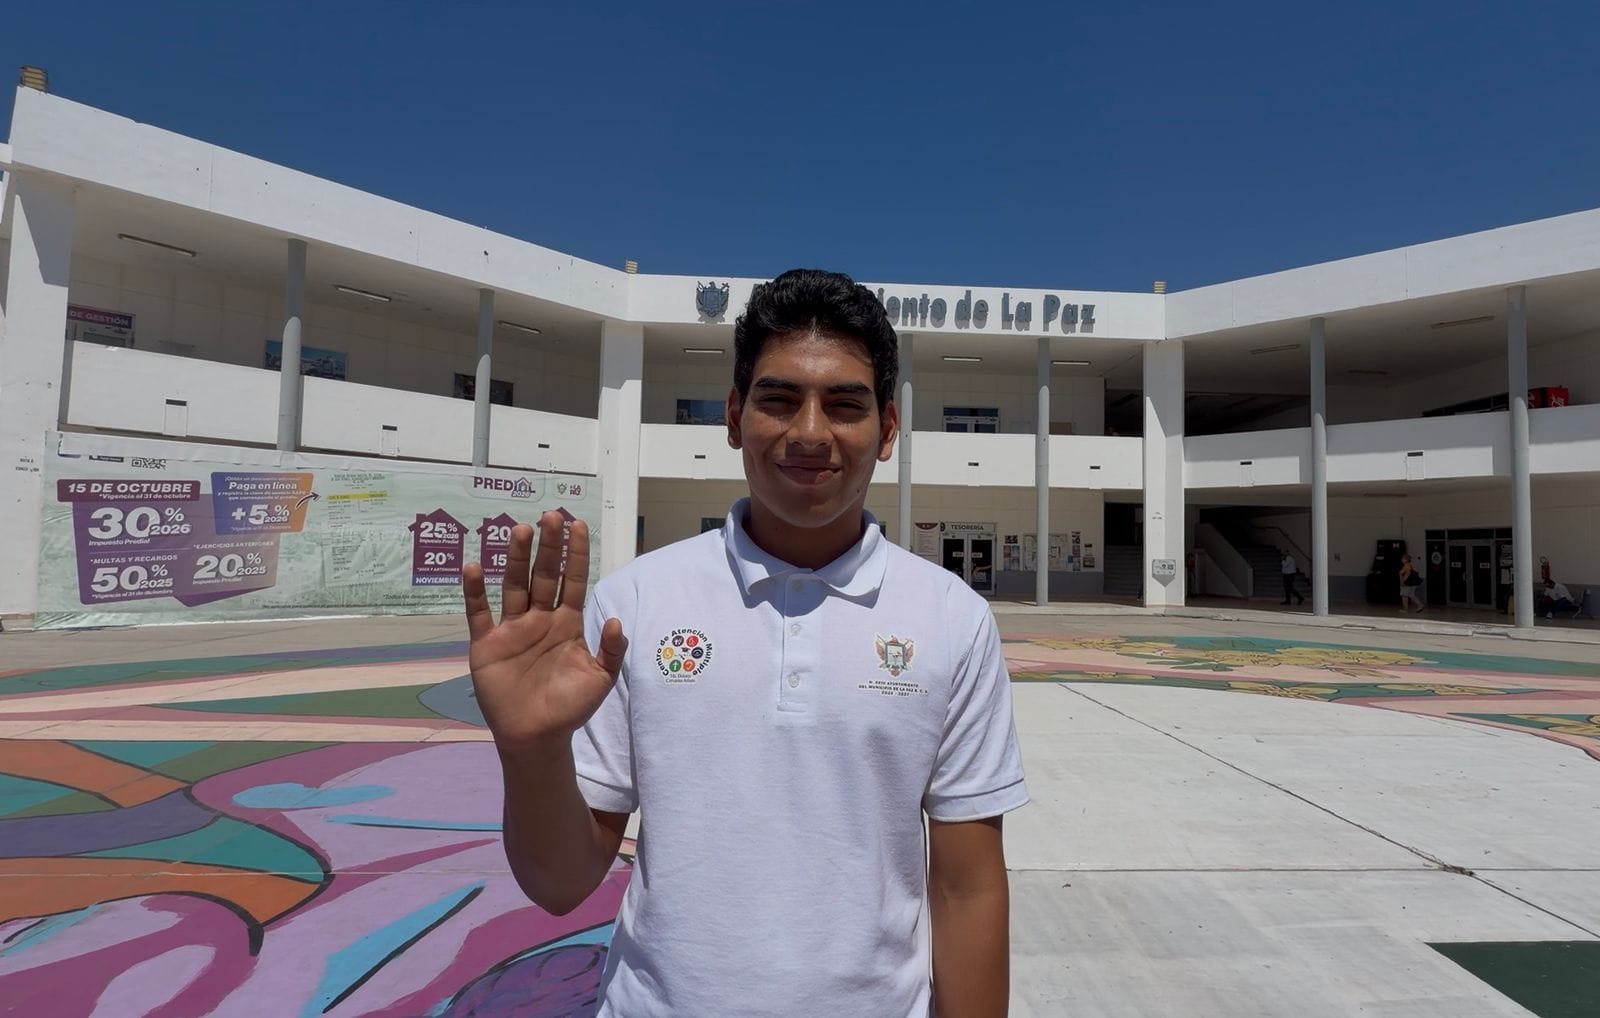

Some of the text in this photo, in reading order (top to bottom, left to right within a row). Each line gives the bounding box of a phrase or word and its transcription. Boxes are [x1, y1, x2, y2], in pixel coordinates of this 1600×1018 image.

[955, 290, 989, 323] de
[1002, 293, 1032, 325] La
[1043, 294, 1096, 327] Paz
[70, 310, 83, 319] DE
[68, 483, 193, 493] 15 DE OCTUBRE
[228, 481, 256, 490] Paga
[272, 481, 297, 489] línea
[150, 524, 192, 535] 2026
[134, 554, 178, 562] RECARGOS
[237, 566, 266, 576] 2025
[140, 578, 173, 589] 2025
[671, 628, 708, 643] Atención
[659, 636, 670, 646] de
[656, 648, 670, 677] Centro
